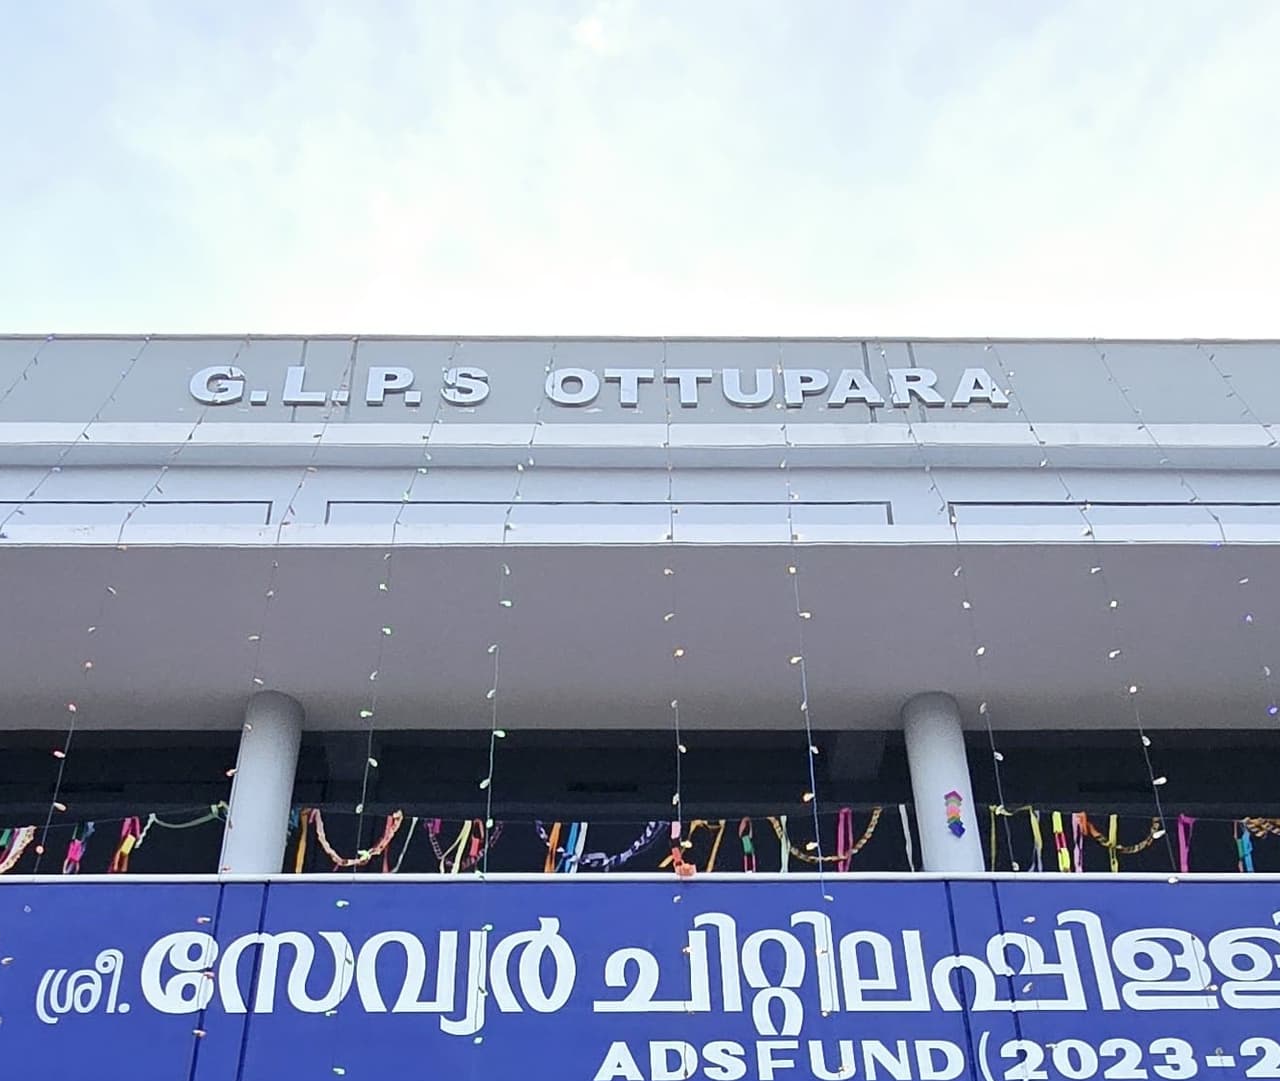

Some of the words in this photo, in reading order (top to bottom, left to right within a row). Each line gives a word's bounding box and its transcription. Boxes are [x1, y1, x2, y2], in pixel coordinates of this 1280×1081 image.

[187, 365, 493, 405] G.L.P.S
[543, 366, 1011, 407] OTTUPARA
[140, 915, 577, 1037] സേവ്യർ
